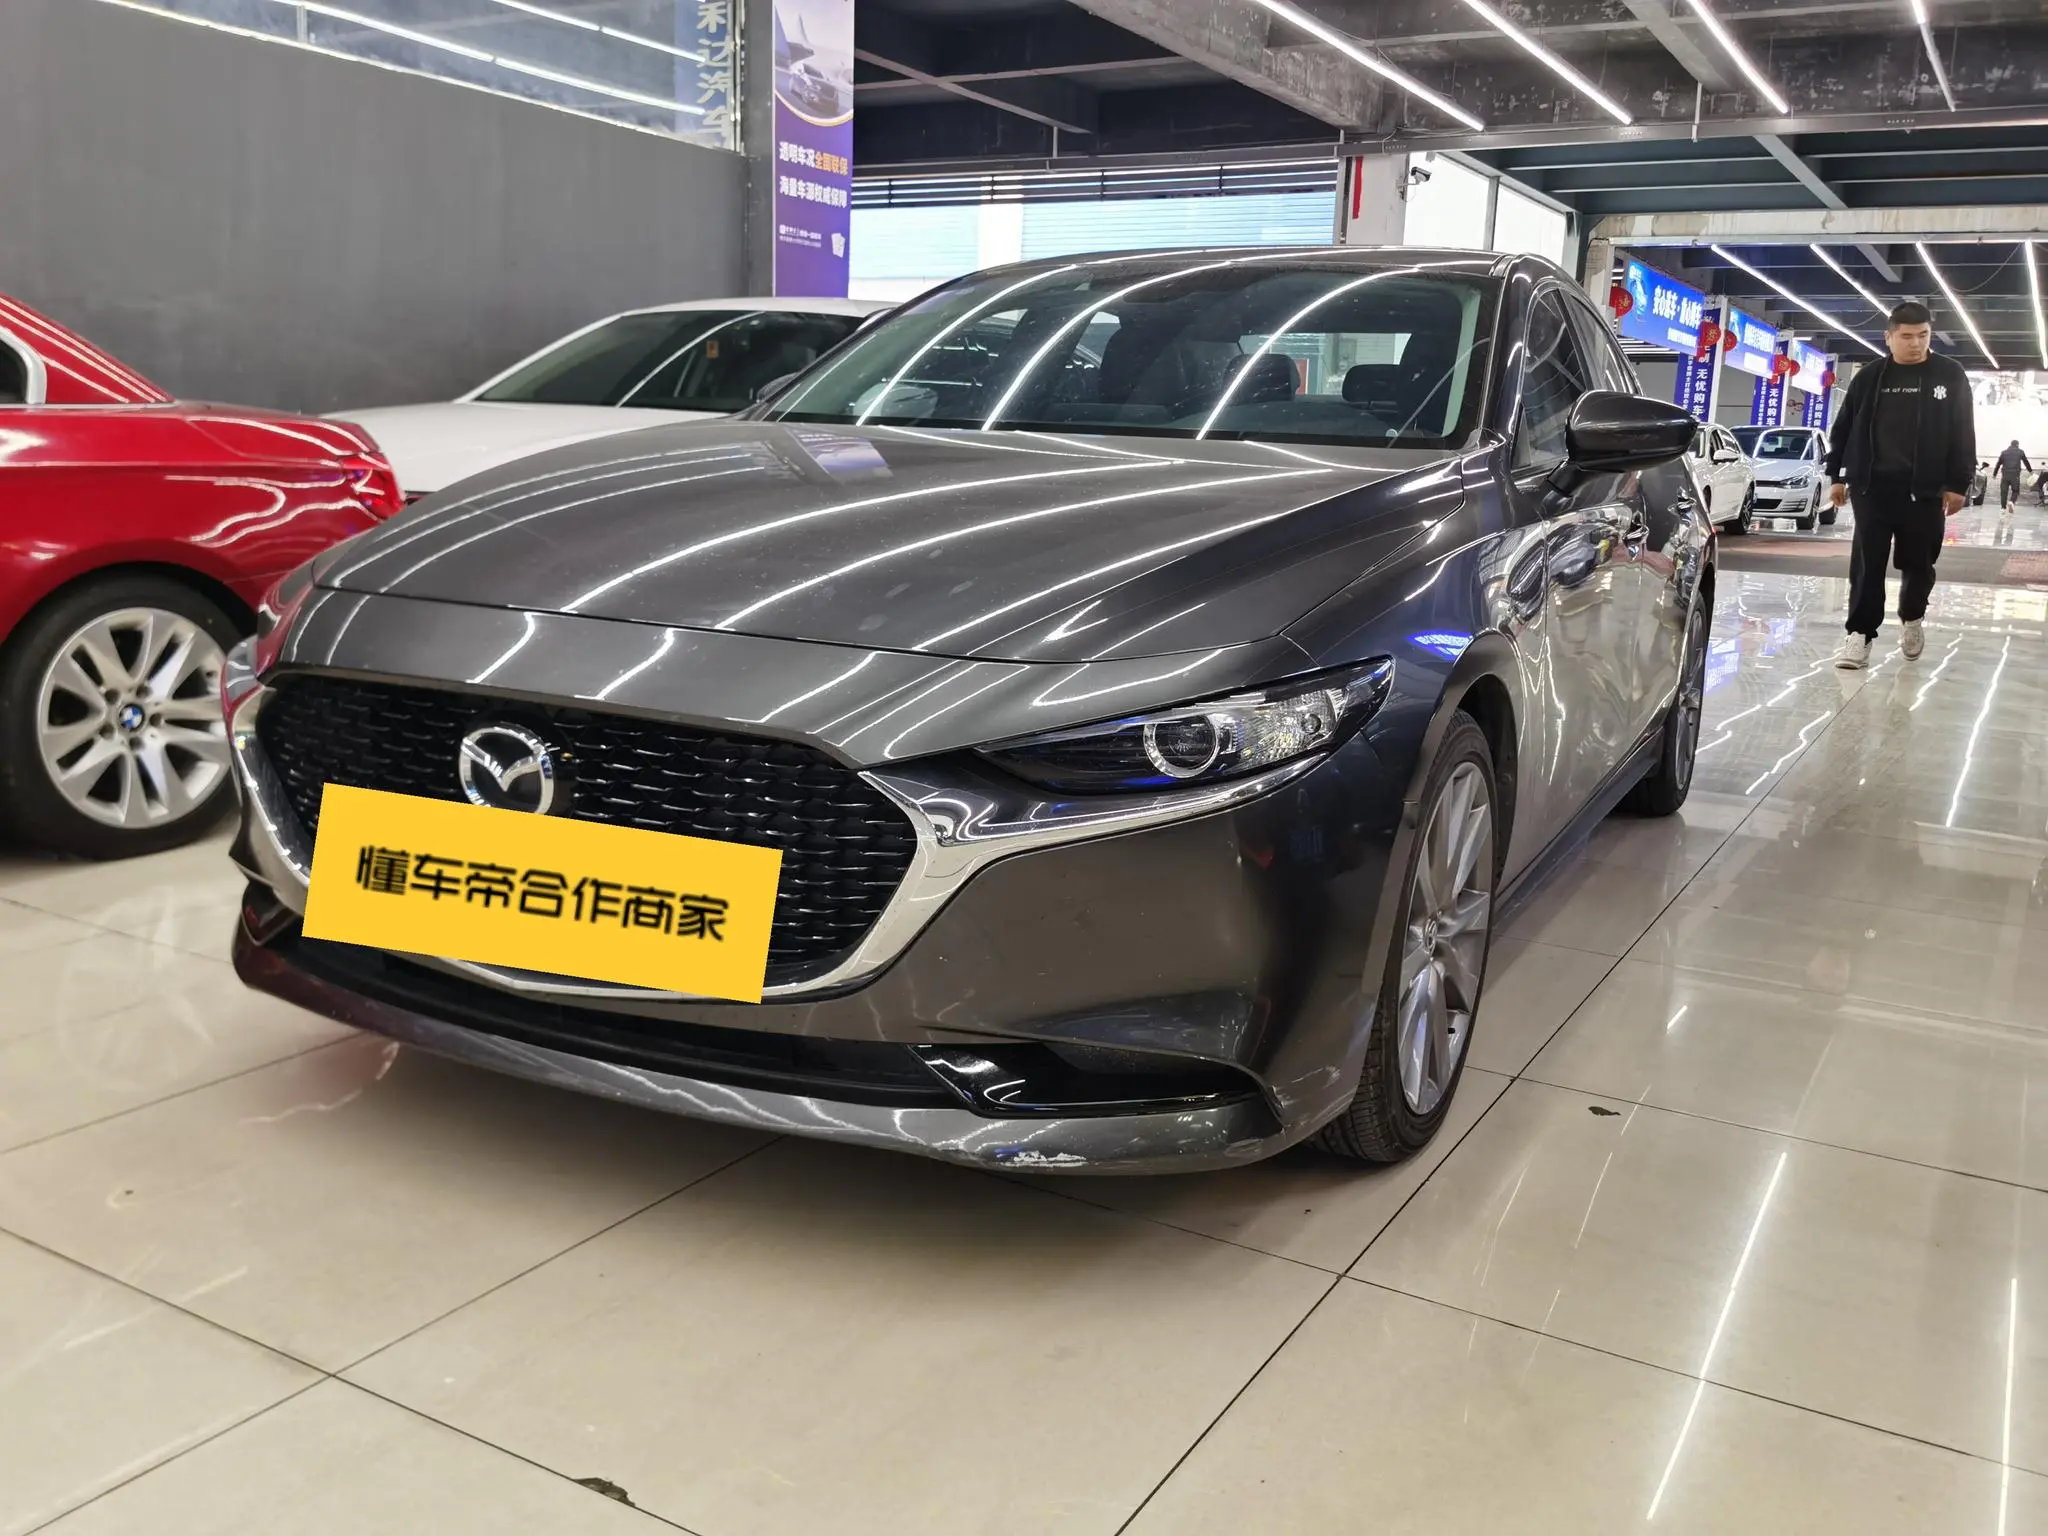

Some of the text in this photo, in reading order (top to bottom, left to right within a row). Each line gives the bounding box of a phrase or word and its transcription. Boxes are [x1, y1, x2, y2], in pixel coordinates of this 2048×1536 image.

[1692, 368, 1708, 416] 无忧购车
[1766, 388, 1780, 426] 无忧购车
